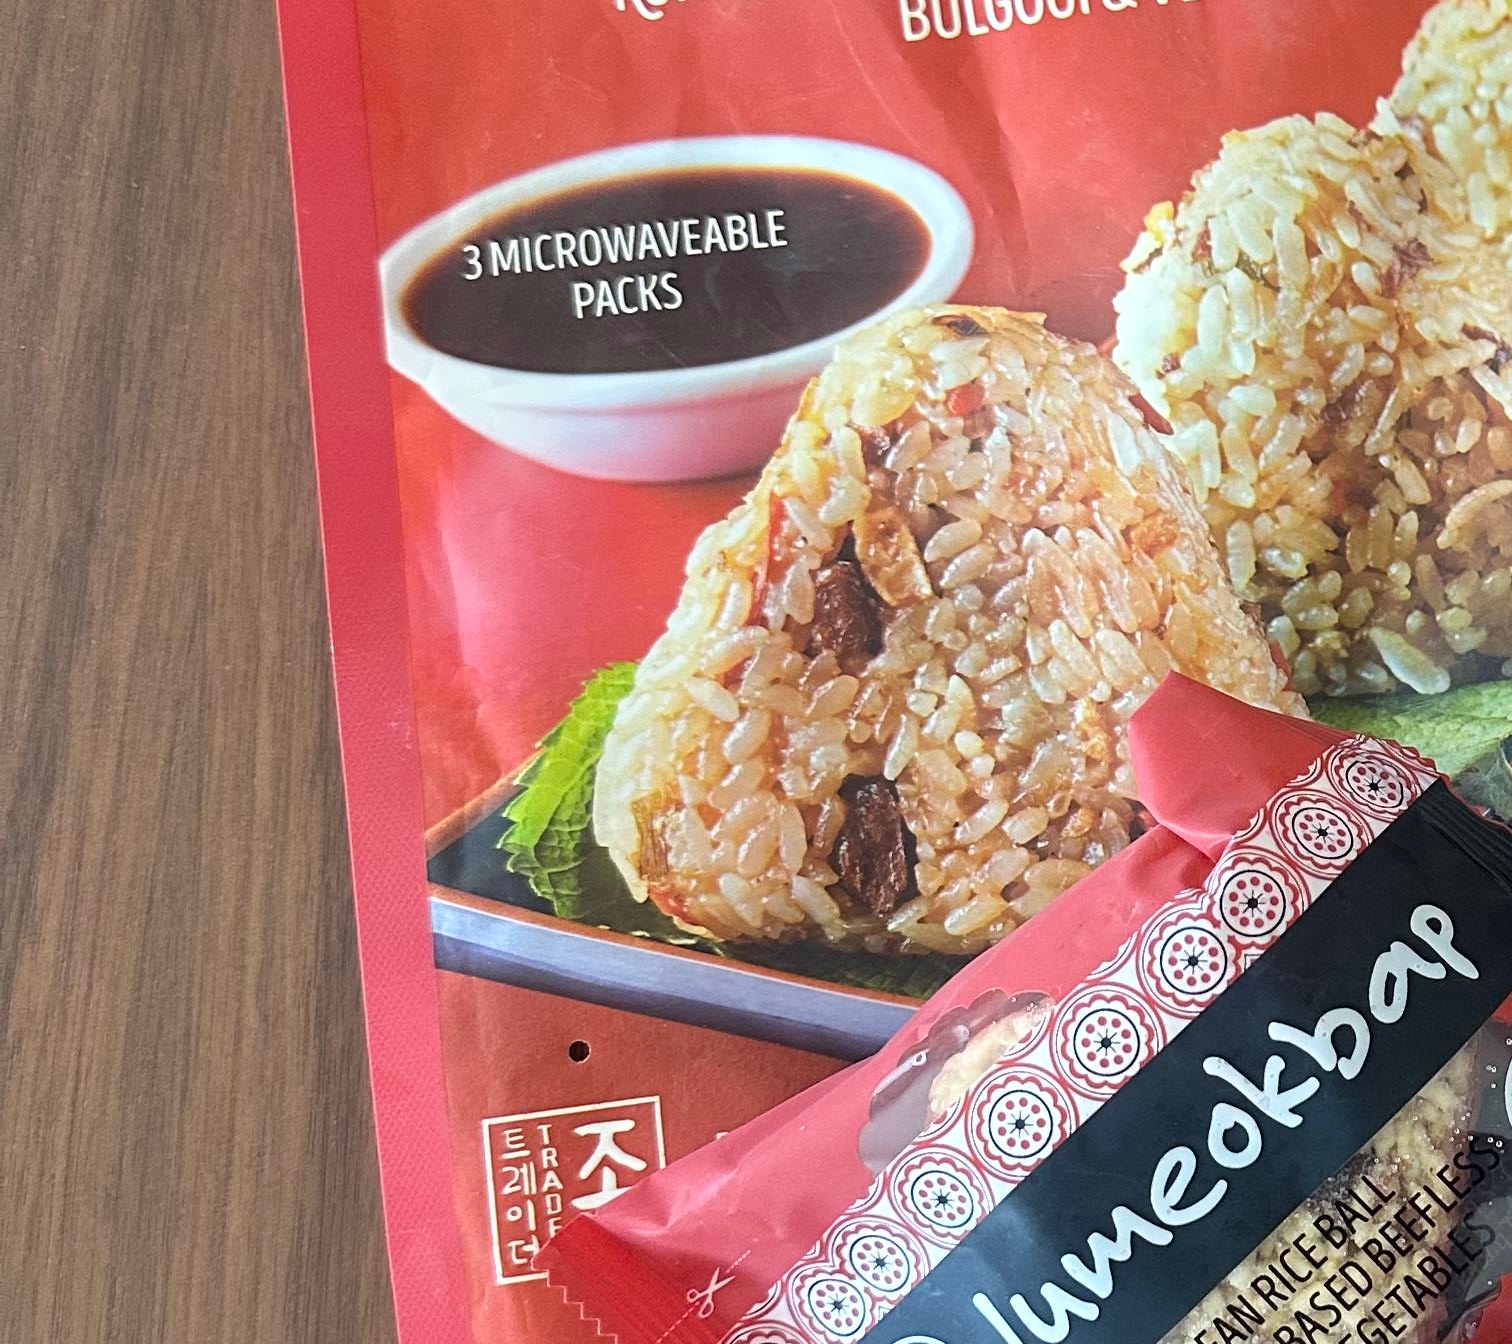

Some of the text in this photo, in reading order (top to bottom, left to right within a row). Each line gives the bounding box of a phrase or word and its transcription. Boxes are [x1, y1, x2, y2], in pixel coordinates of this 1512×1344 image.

[462, 210, 788, 280] 3 MICROWAVEABLE
[572, 273, 684, 320] PACKS
[1258, 1237, 1322, 1314] RICE
[1314, 1175, 1394, 1255] BALL
[1358, 1140, 1503, 1275] BEEFLESS
